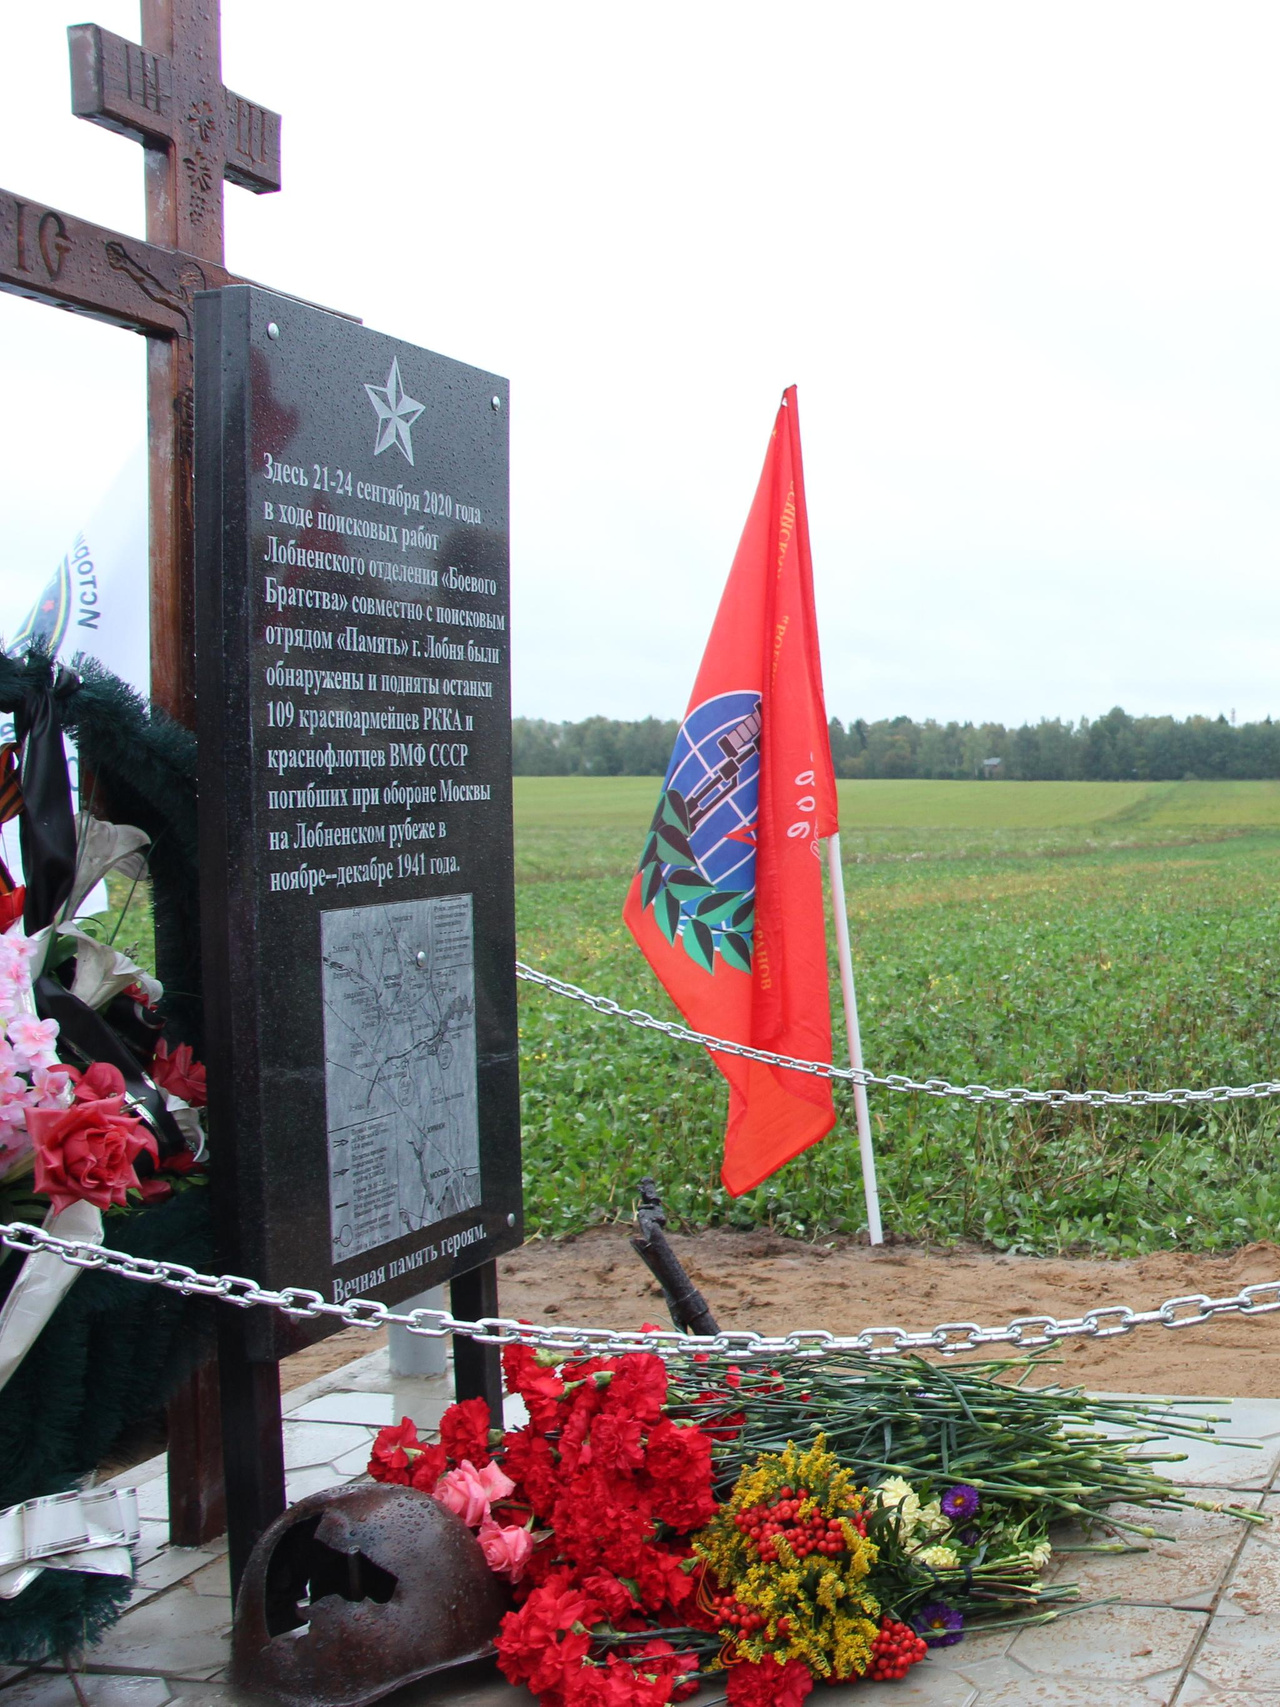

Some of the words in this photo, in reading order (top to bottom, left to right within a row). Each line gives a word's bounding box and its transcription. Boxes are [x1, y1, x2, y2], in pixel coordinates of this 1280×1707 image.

[263, 452, 308, 487] Здесь
[313, 464, 352, 496] 21-24
[357, 481, 420, 516] сентября
[423, 490, 452, 518] 2020
[455, 502, 481, 525] года
[264, 502, 273, 520] в
[278, 505, 313, 529] ходе
[317, 512, 398, 543] поисковых
[401, 524, 439, 552] работ
[264, 535, 365, 576] Лобненского
[369, 560, 438, 587] отделения
[441, 566, 497, 595] «Боевого
[264, 577, 348, 613] Братства»
[351, 594, 423, 621] совместно
[426, 605, 433, 622] с
[436, 607, 505, 631] поисковым
[265, 624, 333, 654] отрядом
[336, 626, 409, 656] «Память»
[412, 638, 421, 657] г.
[424, 635, 464, 660] Лобня
[467, 639, 499, 665] были
[266, 661, 364, 695] обнаружены
[368, 674, 377, 689] и
[381, 677, 439, 697] подняты
[443, 681, 493, 698] останки
[267, 701, 294, 727] 109
[299, 706, 419, 736] красноармейцев
[423, 707, 462, 731] РККА
[465, 716, 473, 732] и
[267, 743, 385, 775] краснофлотцев
[389, 743, 426, 768] ВМФ
[429, 743, 469, 767] СССР
[268, 782, 348, 809] погибших
[352, 788, 379, 813] при
[383, 781, 436, 810] обороне
[439, 779, 491, 802] Москвы
[269, 830, 289, 850] на
[294, 822, 385, 850] Лобненском
[389, 817, 435, 848] рубеже
[438, 822, 446, 839] в
[397, 853, 426, 878] 1941
[430, 856, 460, 879] года.
[332, 1265, 386, 1304] Вечная
[389, 1246, 437, 1280] память
[440, 1224, 487, 1258] героям.
